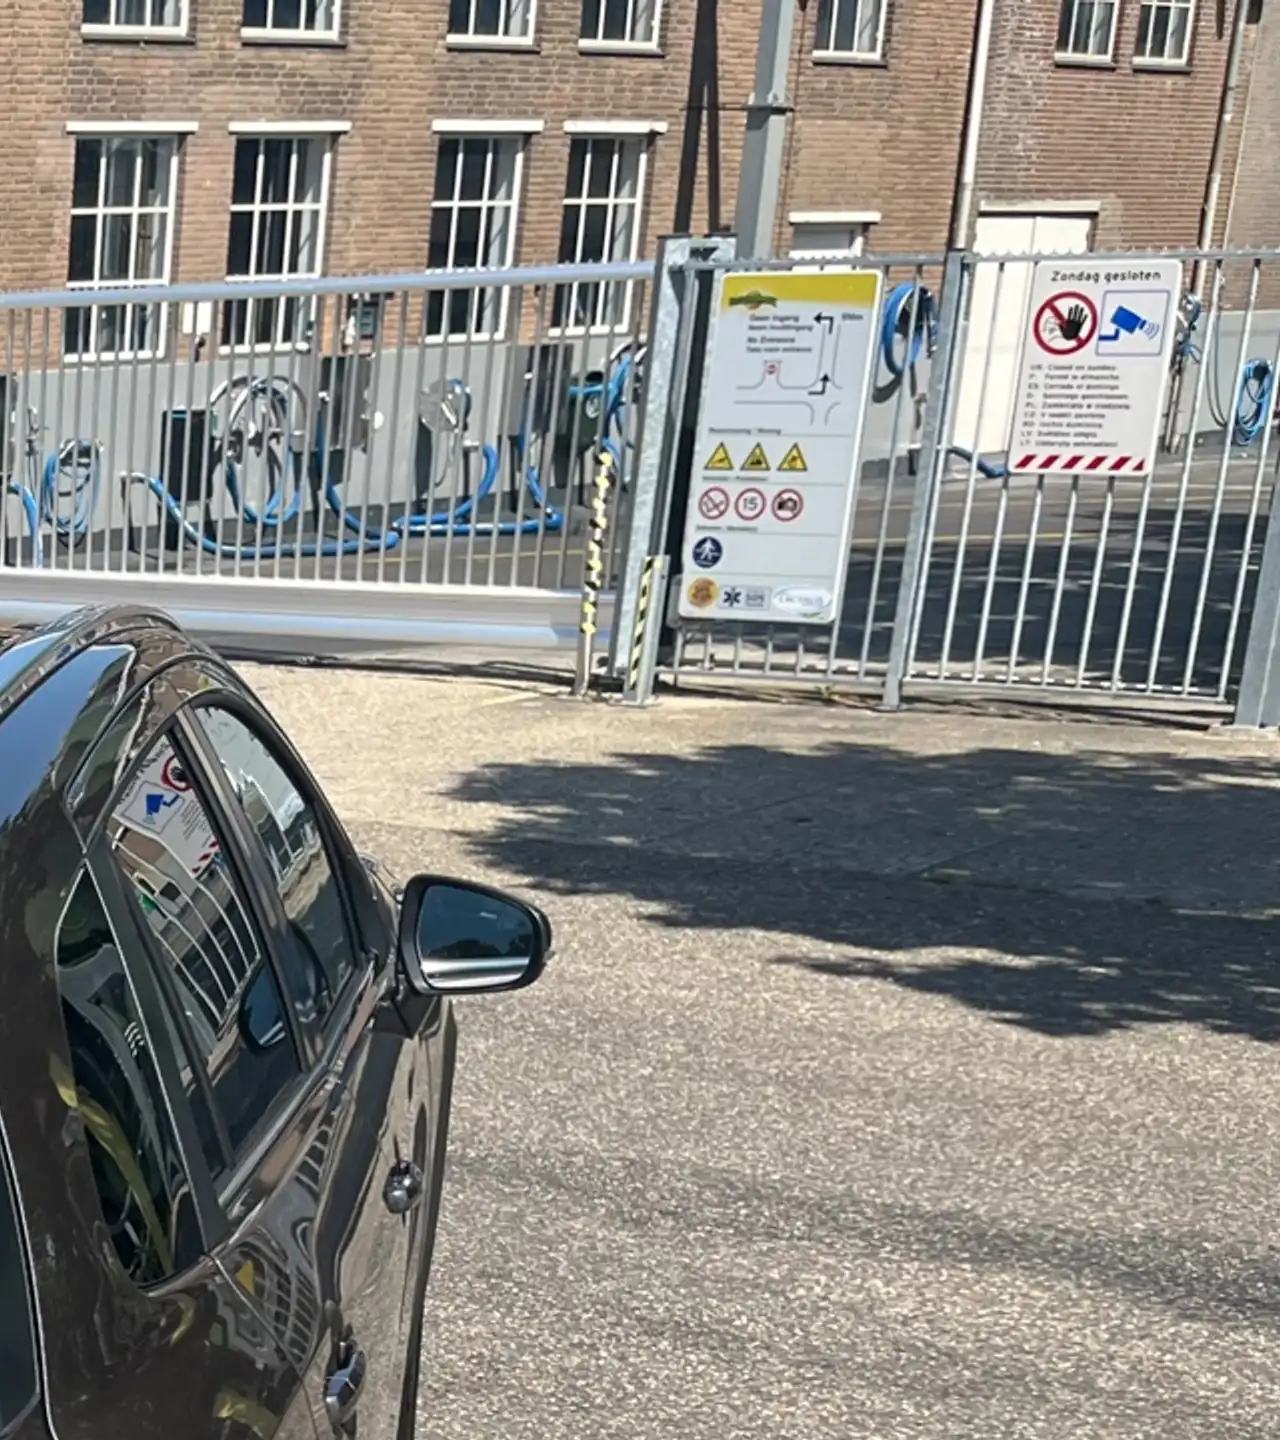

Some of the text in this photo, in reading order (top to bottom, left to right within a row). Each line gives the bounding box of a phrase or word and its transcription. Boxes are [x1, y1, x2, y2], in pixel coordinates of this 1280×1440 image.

[1050, 269, 1162, 284] Zondag gesloten
[742, 496, 759, 511] 15
